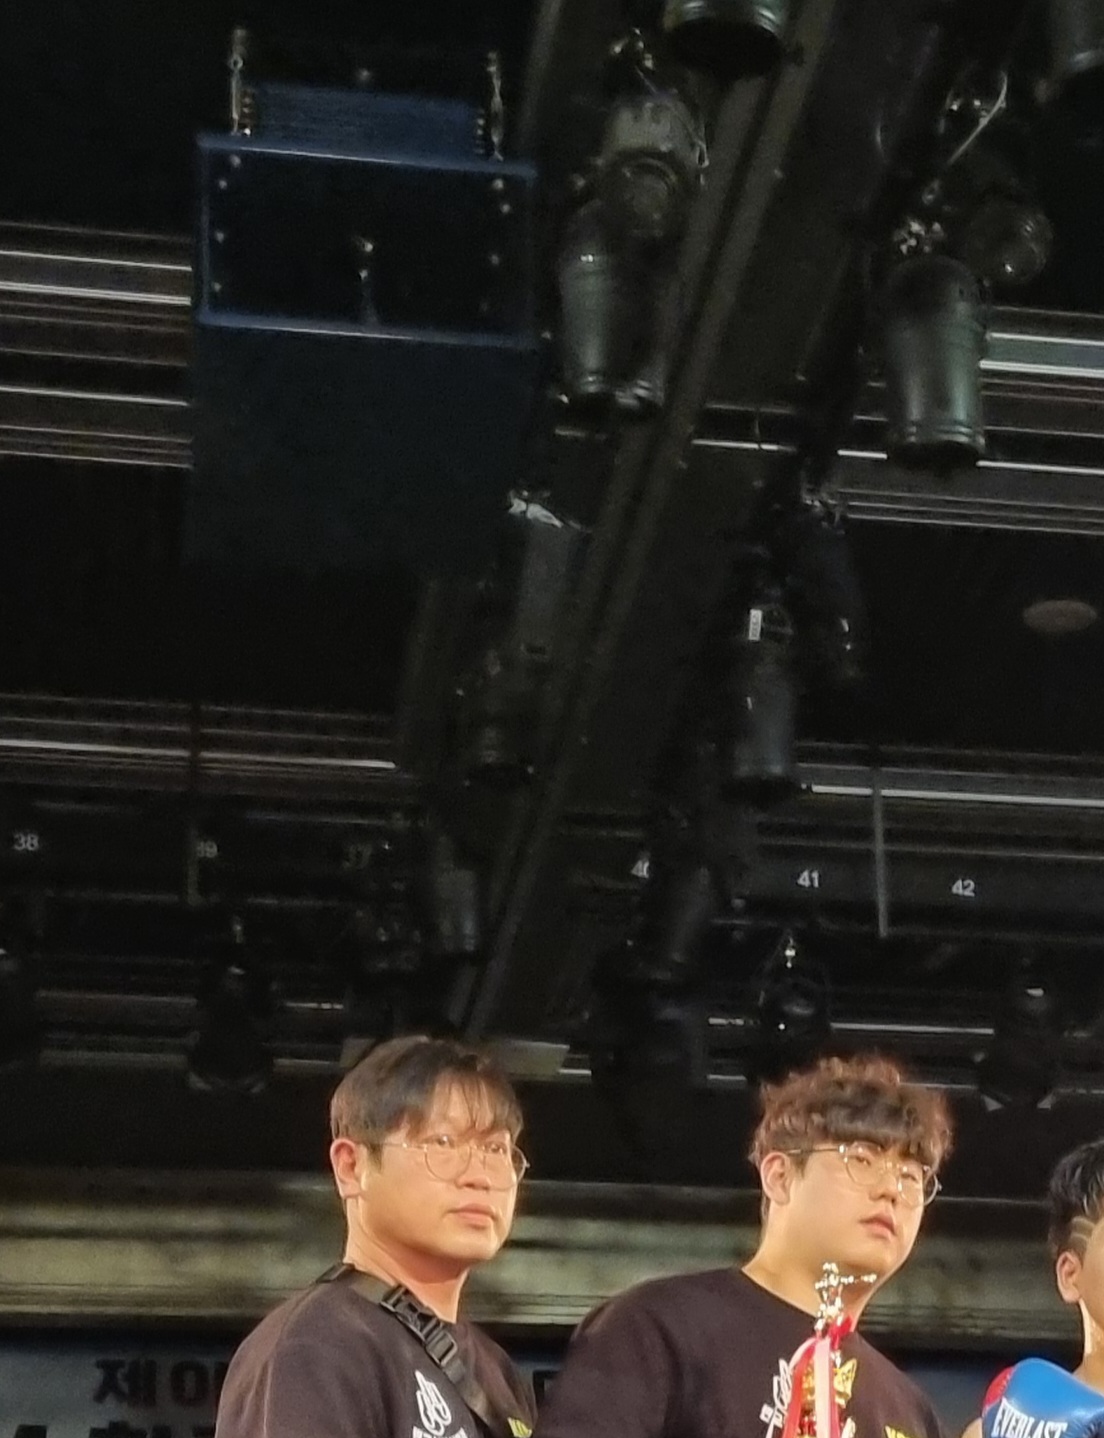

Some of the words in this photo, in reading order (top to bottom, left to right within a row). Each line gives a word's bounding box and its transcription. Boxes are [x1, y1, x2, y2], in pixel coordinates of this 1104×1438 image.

[13, 833, 39, 852] 38
[797, 869, 819, 888] 41
[951, 878, 975, 897] 42
